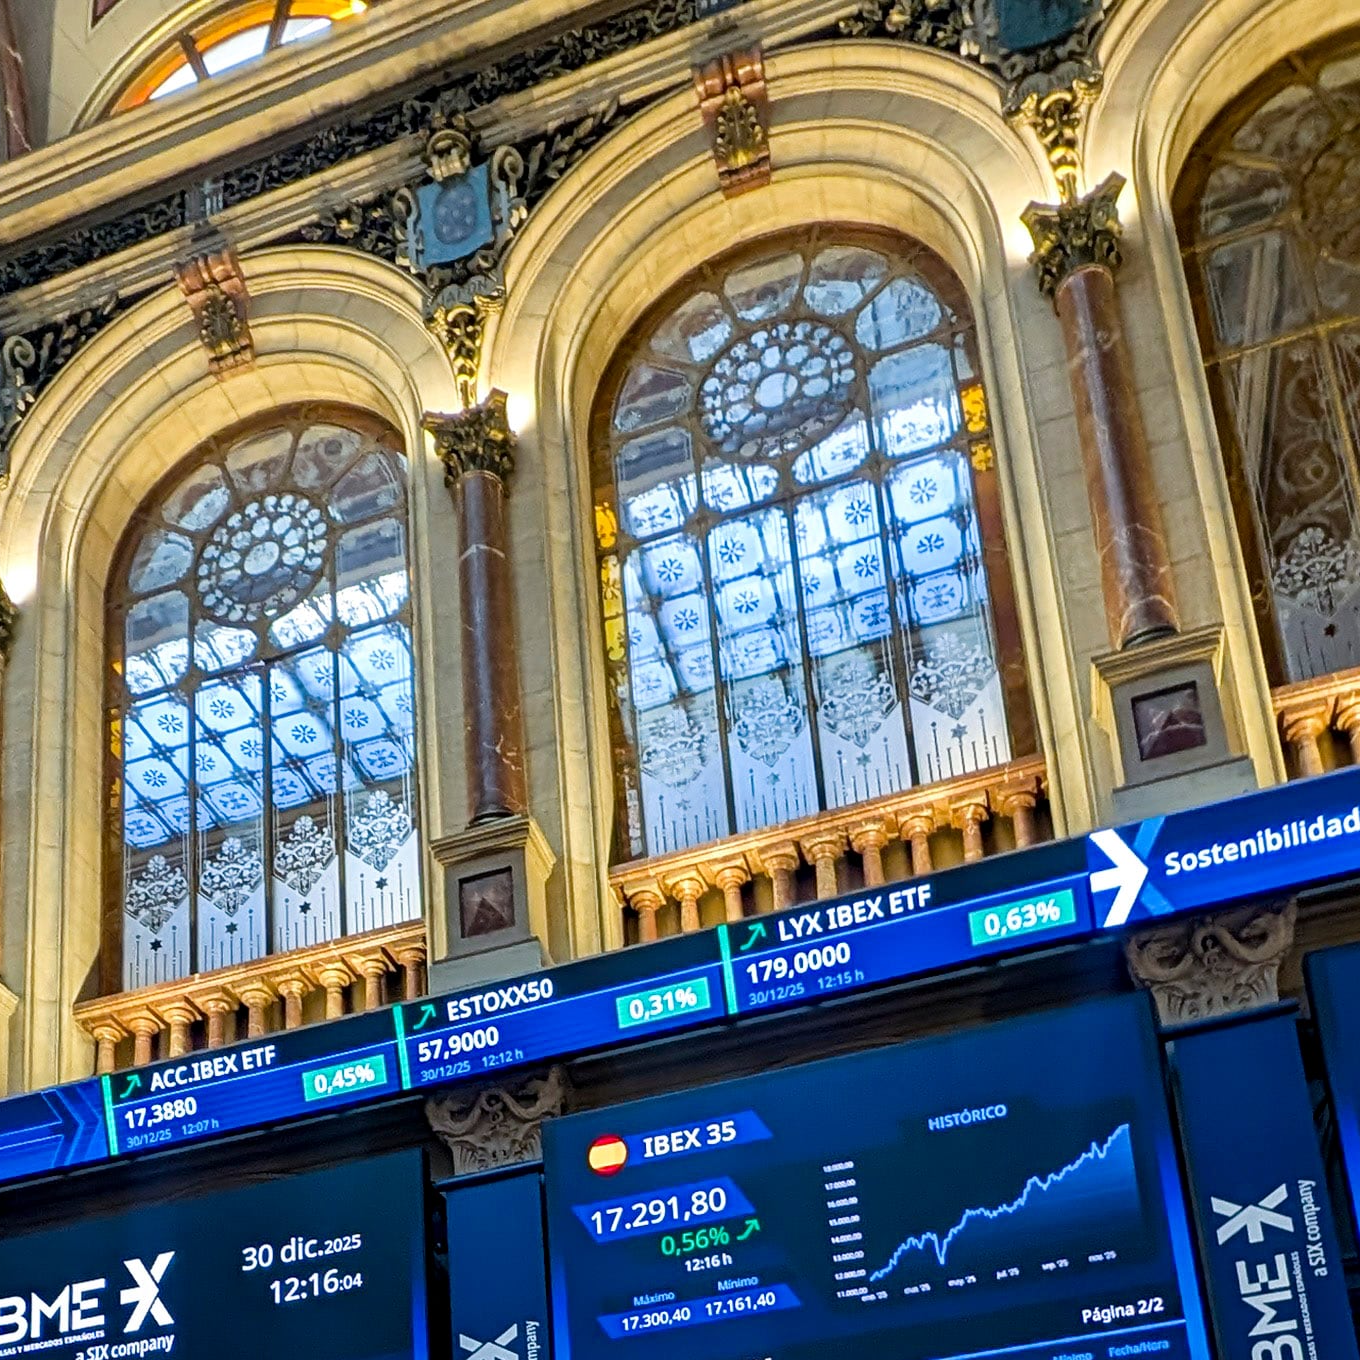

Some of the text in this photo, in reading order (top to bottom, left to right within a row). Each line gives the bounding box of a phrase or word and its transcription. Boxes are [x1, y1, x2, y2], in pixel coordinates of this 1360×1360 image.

[778, 885, 931, 942] LYX IBEX ETF
[983, 898, 1061, 938] 0,63%
[746, 942, 851, 985] 179,0000
[447, 977, 554, 1022] ESTOXX50
[629, 986, 698, 1020] 0,31%
[748, 971, 852, 1006] 30/12/25 12:15
[418, 1026, 499, 1064] 57,9000
[150, 1044, 276, 1093] ACC.IBEX ETF
[314, 1064, 375, 1095] 0,45%
[421, 1050, 512, 1082] 30/12/25 12:12
[124, 1096, 198, 1130] 17,3880
[928, 1104, 1007, 1131] HISTÓRICO
[126, 1119, 210, 1149] 30/12/25 12:07
[643, 1120, 737, 1158] IBEX 35
[591, 1186, 727, 1235] 17.291,80
[1298, 1179, 1326, 1267] SIX company
[661, 1225, 730, 1256] 0,56%
[242, 1245, 274, 1272] 30
[685, 1256, 721, 1273] 12:16
[269, 1268, 363, 1305] 12:16:04
[634, 1275, 759, 1307] Máximo Mínimo
[622, 1291, 776, 1332] 17.300,40 17.161,40
[1081, 1297, 1164, 1325] Página 2/2
[111, 1333, 175, 1360] company
[1108, 1338, 1170, 1359] Fecha/Hora
